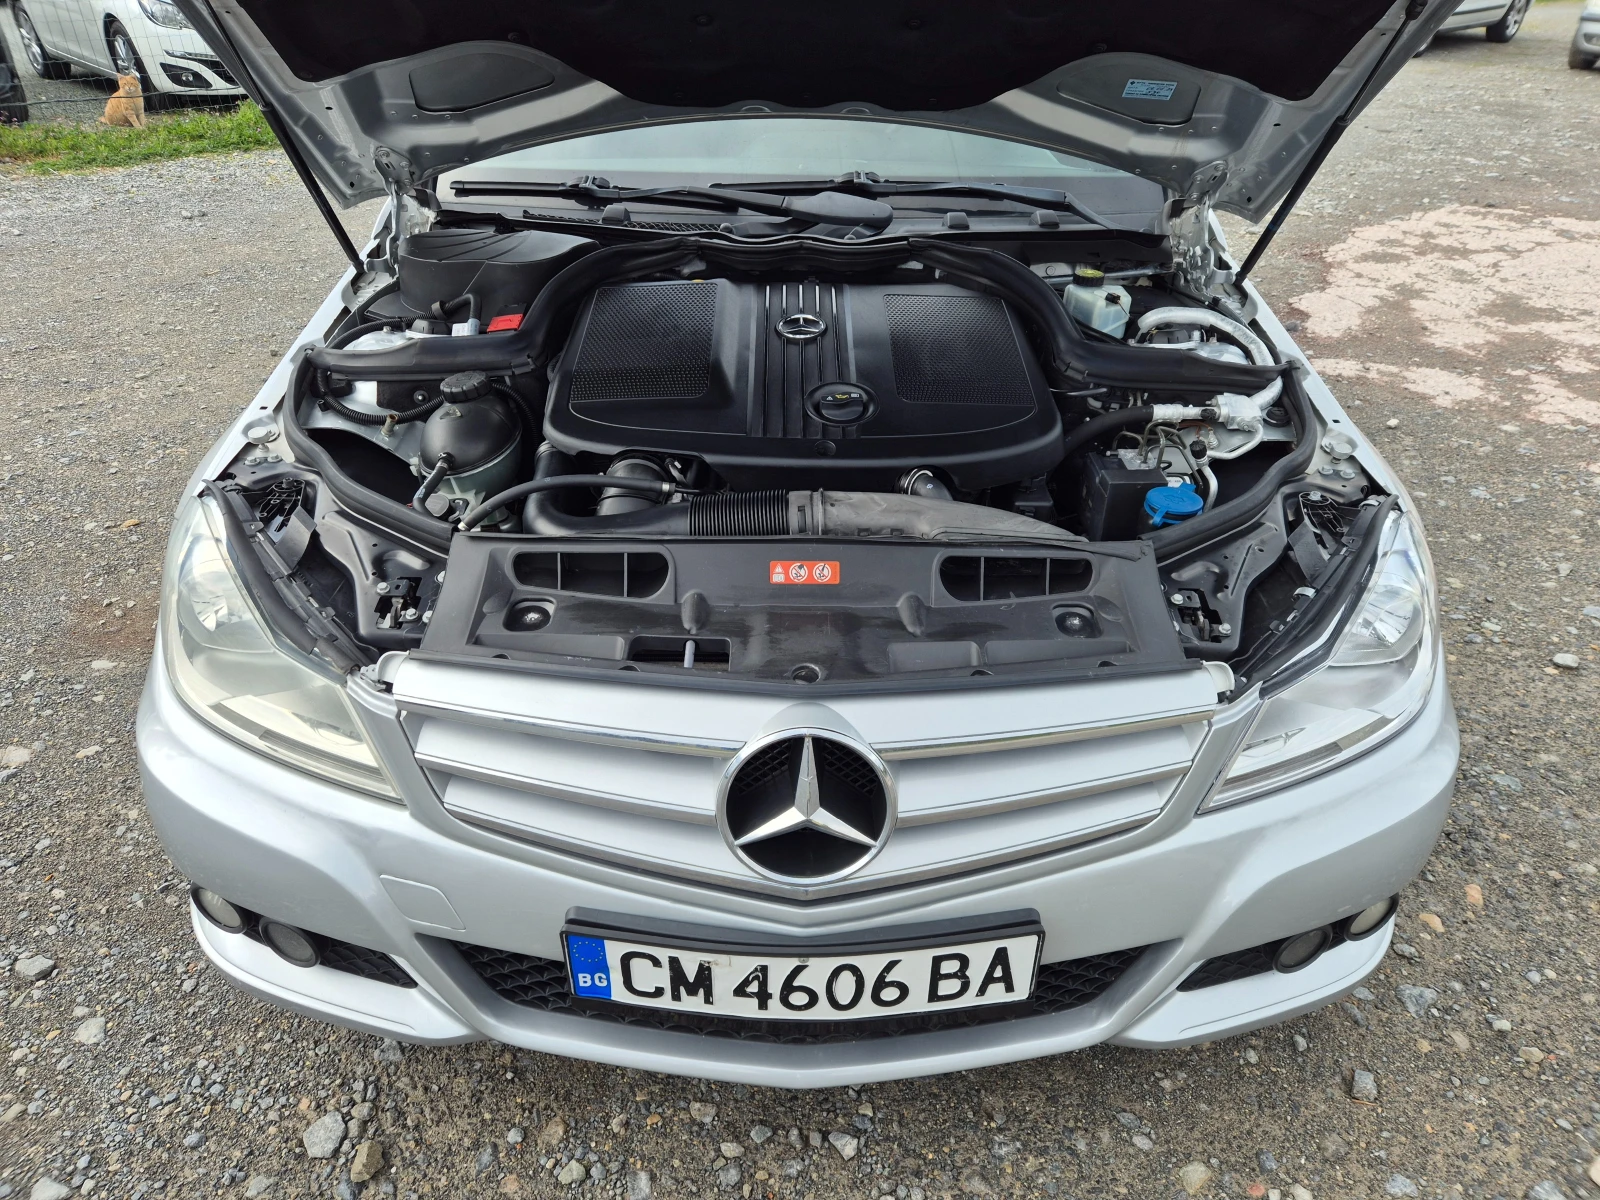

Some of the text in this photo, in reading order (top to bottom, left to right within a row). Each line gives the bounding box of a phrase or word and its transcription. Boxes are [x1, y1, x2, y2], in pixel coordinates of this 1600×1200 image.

[577, 972, 608, 987] BG
[619, 946, 1016, 1011] CM 4606 BA
